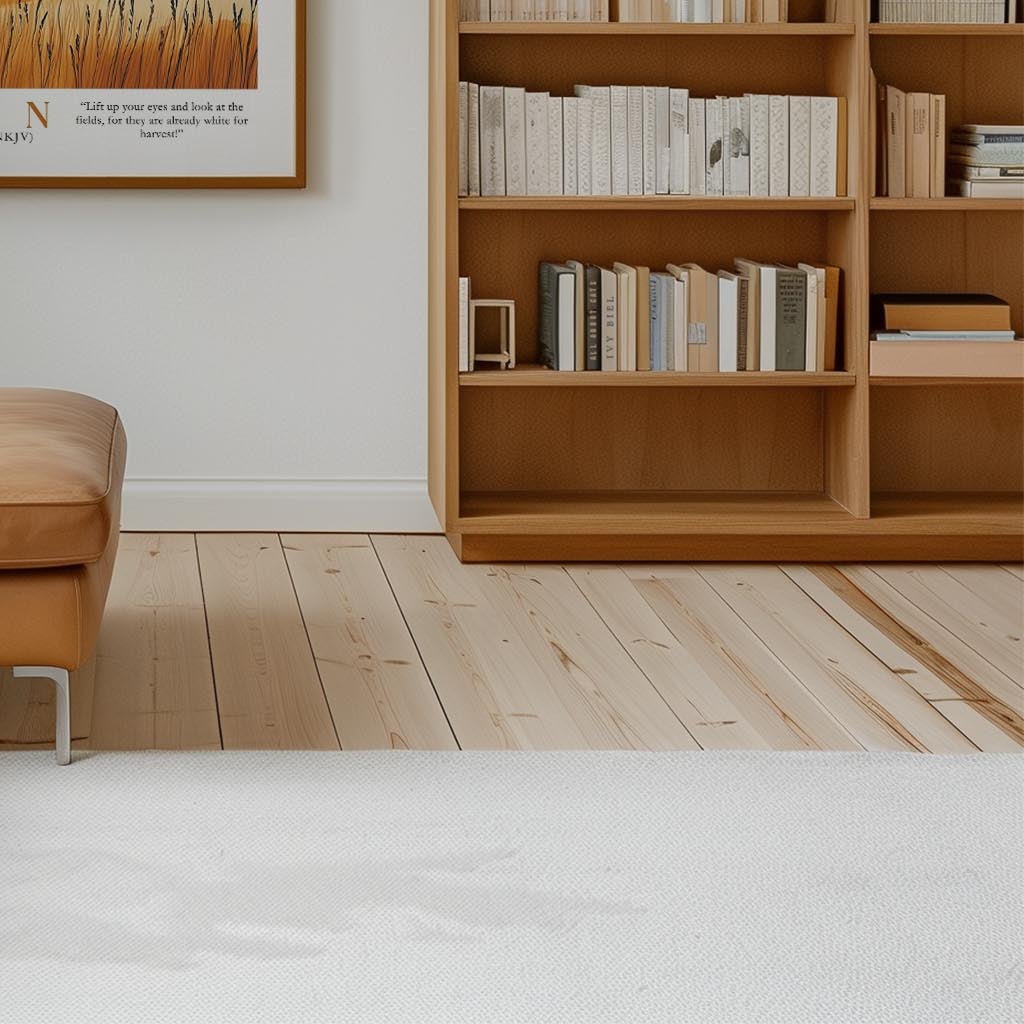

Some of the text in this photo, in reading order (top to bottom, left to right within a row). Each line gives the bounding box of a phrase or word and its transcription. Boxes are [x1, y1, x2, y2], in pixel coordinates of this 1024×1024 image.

[75, 115, 105, 126] fields,
[108, 115, 123, 125] for
[126, 115, 146, 127] they
[166, 115, 201, 127] already
[204, 115, 231, 125] white
[233, 115, 249, 125] for
[107, 104, 120, 114] up
[122, 104, 145, 114] your
[147, 104, 168, 114] eyes
[171, 102, 188, 111] and
[191, 102, 213, 111] look
[228, 102, 244, 111] the
[589, 281, 597, 360] ALL ABOUT CATS
[606, 296, 614, 358] IVY BIEL
